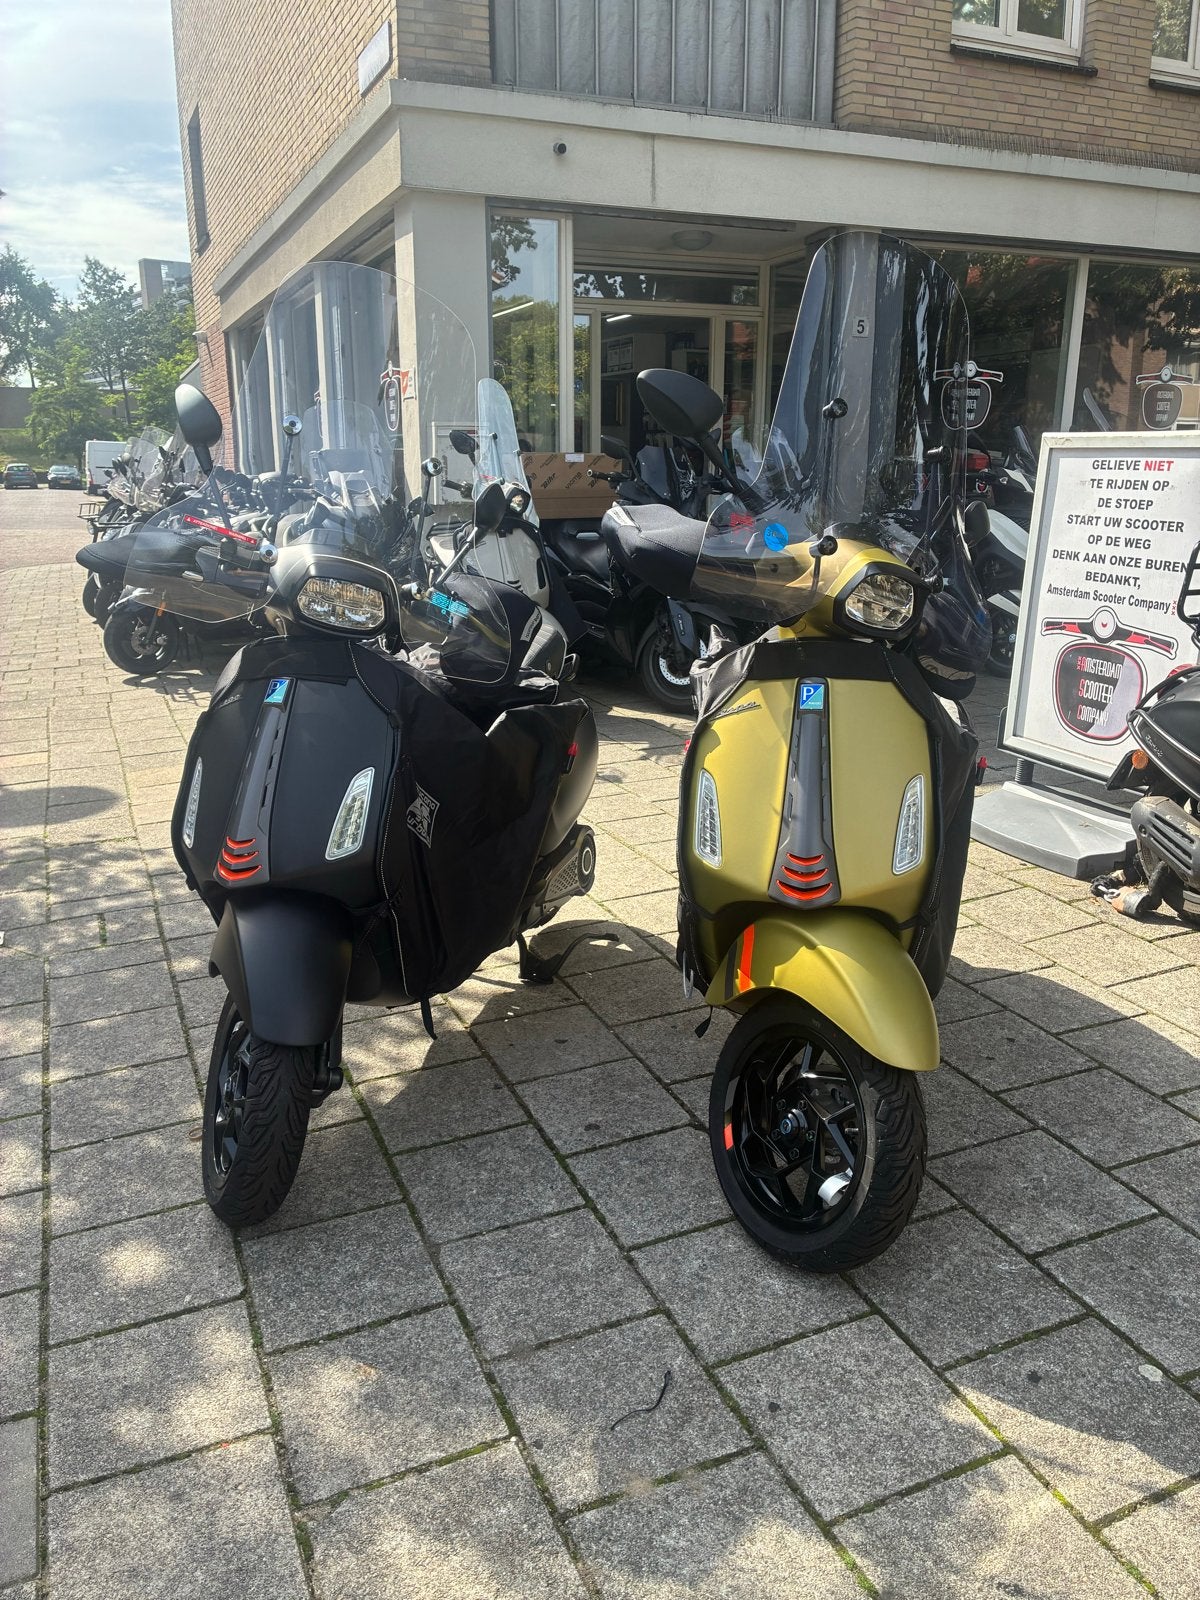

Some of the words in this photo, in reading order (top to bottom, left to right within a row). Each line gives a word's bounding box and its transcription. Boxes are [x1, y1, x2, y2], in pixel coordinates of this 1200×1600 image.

[857, 319, 865, 334] 5
[1092, 460, 1141, 471] GELIEVE
[1143, 460, 1174, 472] NIET
[1090, 478, 1103, 489] TE
[1106, 479, 1149, 491] RIJDEN
[1152, 480, 1170, 492] OP
[1097, 497, 1112, 508] DE
[1115, 498, 1154, 511] STOEP
[1067, 514, 1101, 527] START
[1104, 517, 1123, 528] UW
[1125, 518, 1185, 533] SCOOTER
[1087, 534, 1103, 545] OP
[1105, 535, 1121, 547] DE
[1124, 537, 1152, 550] WEG
[1052, 549, 1081, 561] DENK
[1083, 552, 1107, 564] AAN
[1109, 555, 1142, 568] ONZE
[1145, 558, 1189, 573] BUREN
[1085, 571, 1141, 590] BEDANKT,
[1046, 583, 1091, 600] Amsterdam
[1092, 590, 1126, 605] Scooter
[1128, 594, 1171, 615] Company
[802, 686, 815, 701] P
[1078, 678, 1114, 704] SCOOTER
[1076, 704, 1109, 727] COMPANY
